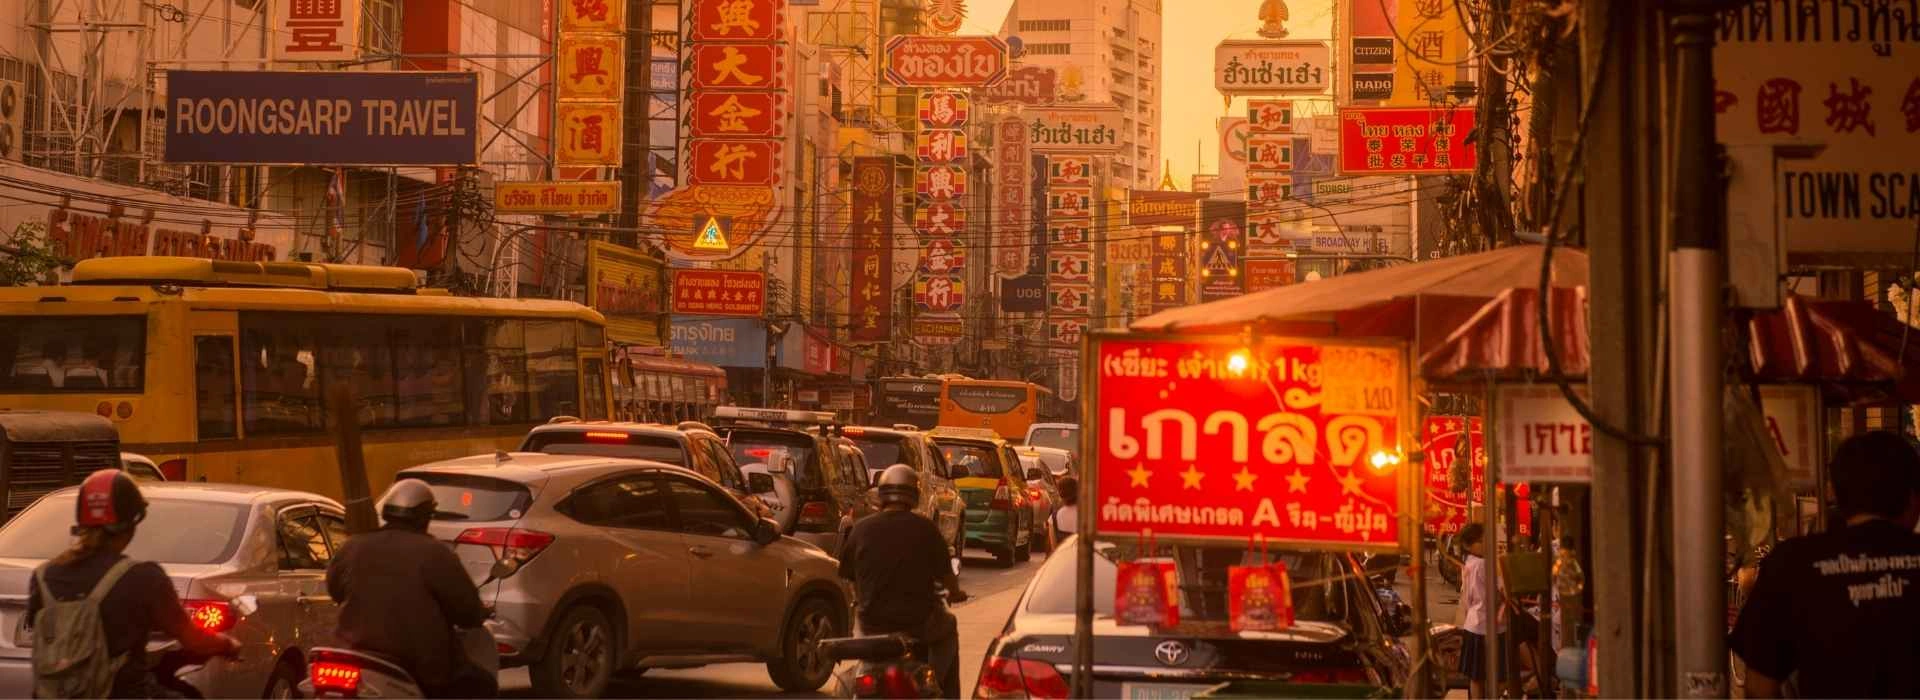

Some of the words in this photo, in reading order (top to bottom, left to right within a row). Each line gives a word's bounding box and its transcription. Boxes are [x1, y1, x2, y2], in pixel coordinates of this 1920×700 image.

[1354, 47, 1391, 56] CITIZEN
[1355, 80, 1391, 90] RADO
[176, 98, 352, 136] ROONGSARP
[361, 99, 466, 136] TRAVEL
[1784, 173, 1860, 219] TOWN
[1016, 287, 1041, 298] UOB
[1109, 388, 1384, 467] เกาลัด
[1252, 498, 1281, 528] A
[1024, 643, 1065, 654] CAMRY
